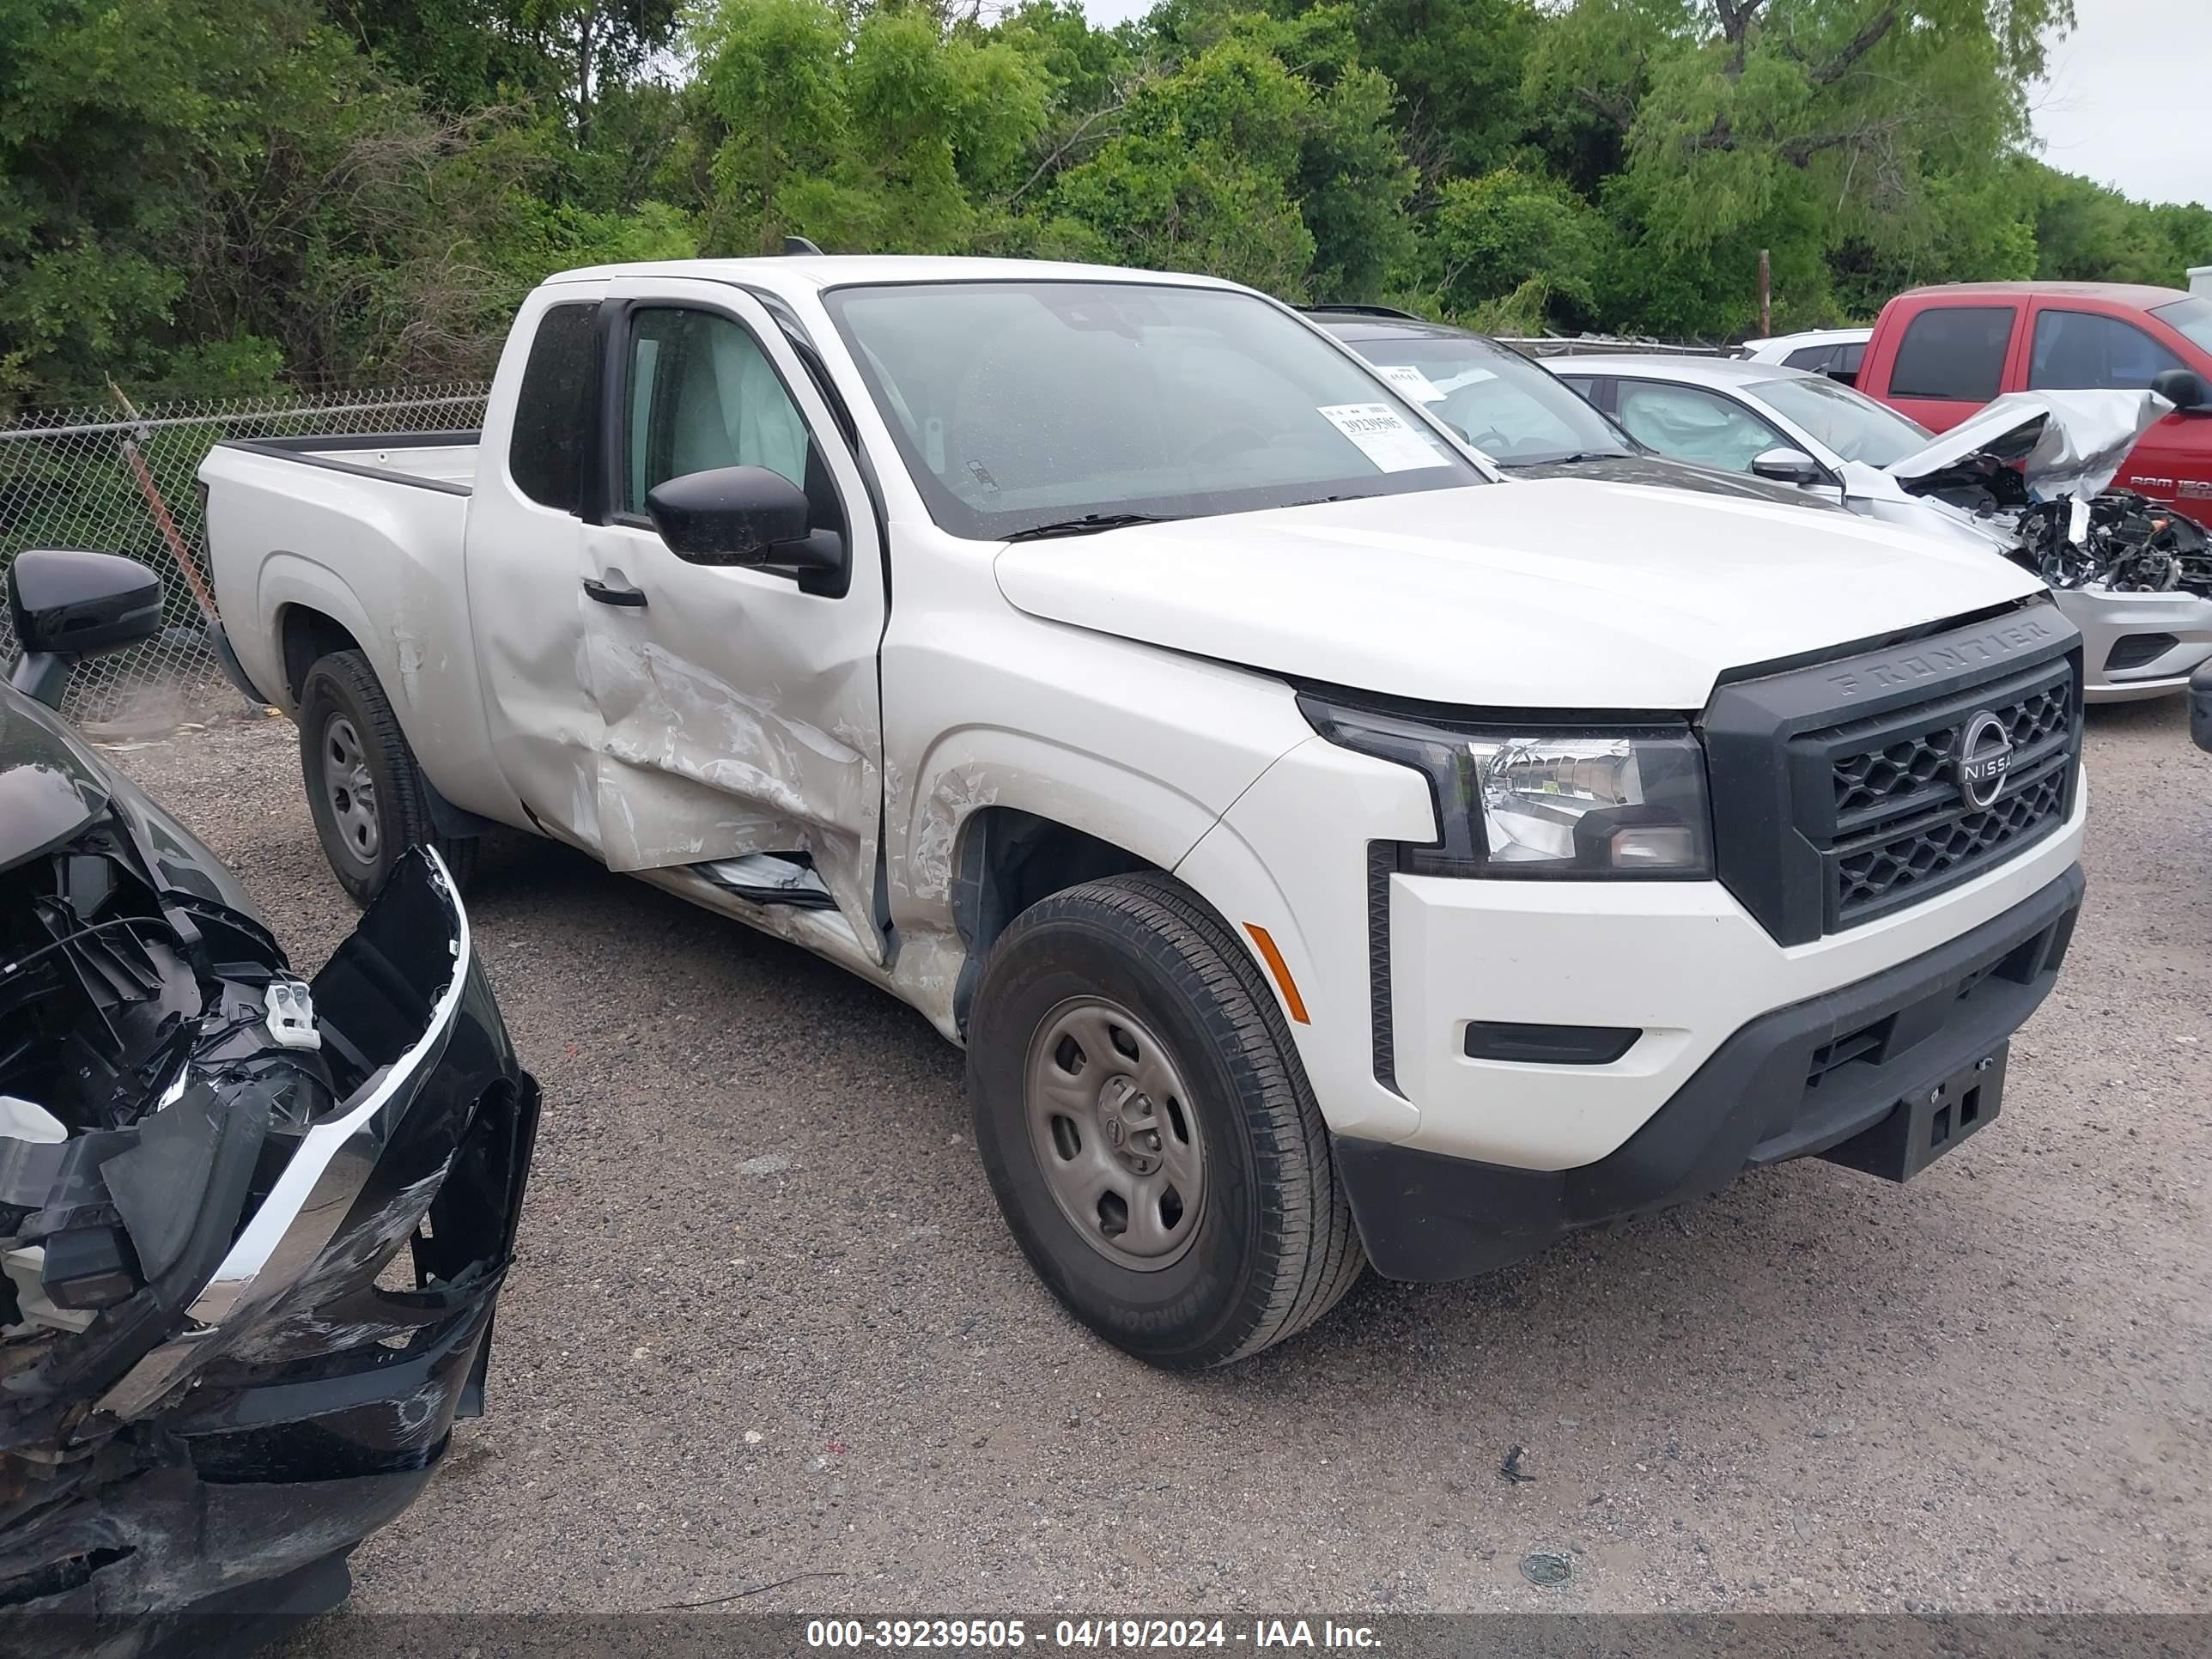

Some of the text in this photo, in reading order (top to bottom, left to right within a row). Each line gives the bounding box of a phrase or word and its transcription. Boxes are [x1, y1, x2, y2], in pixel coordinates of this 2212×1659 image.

[1341, 417, 1402, 433] 39239505
[2130, 477, 2212, 489] RAM 150
[1826, 620, 2052, 696] FRONTIER
[1964, 754, 2012, 781] NISSA
